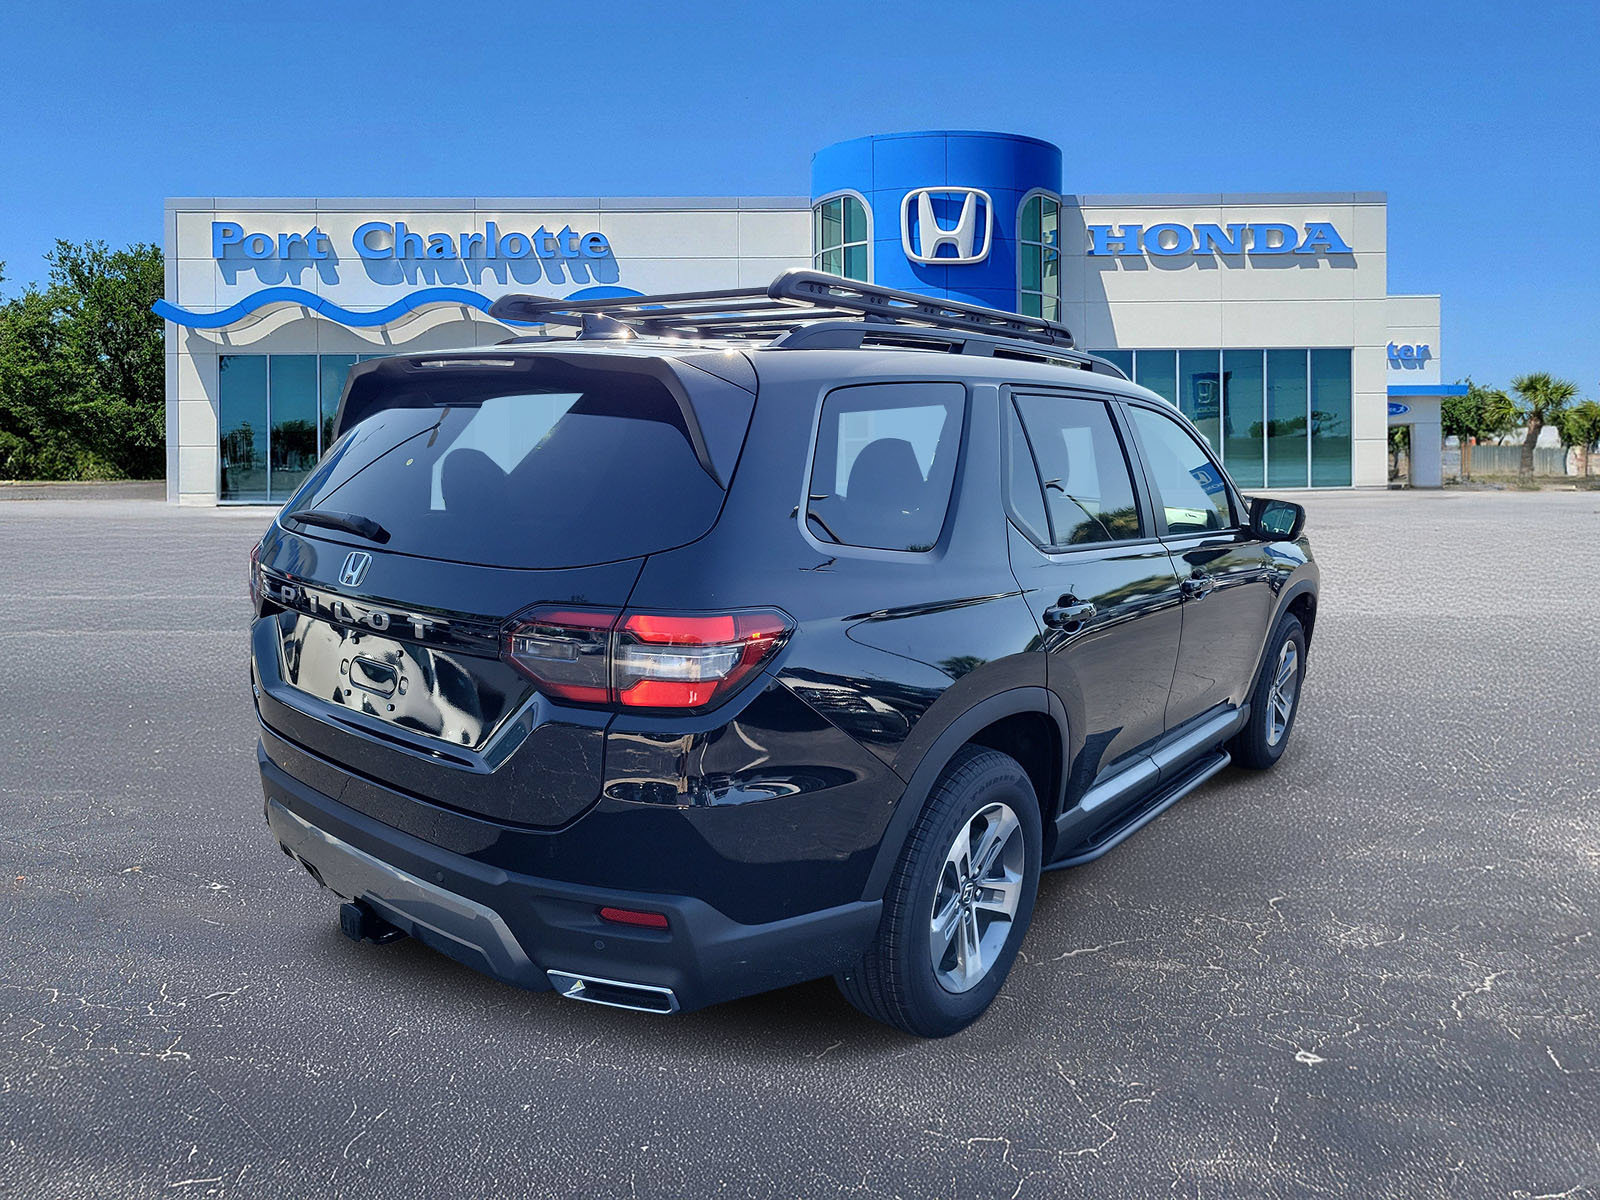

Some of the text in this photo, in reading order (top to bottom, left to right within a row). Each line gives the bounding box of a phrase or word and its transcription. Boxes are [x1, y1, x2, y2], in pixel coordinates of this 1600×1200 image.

[211, 221, 609, 260] Port Charlotte
[1087, 222, 1352, 256] HONDA
[280, 585, 433, 639] PILOT
